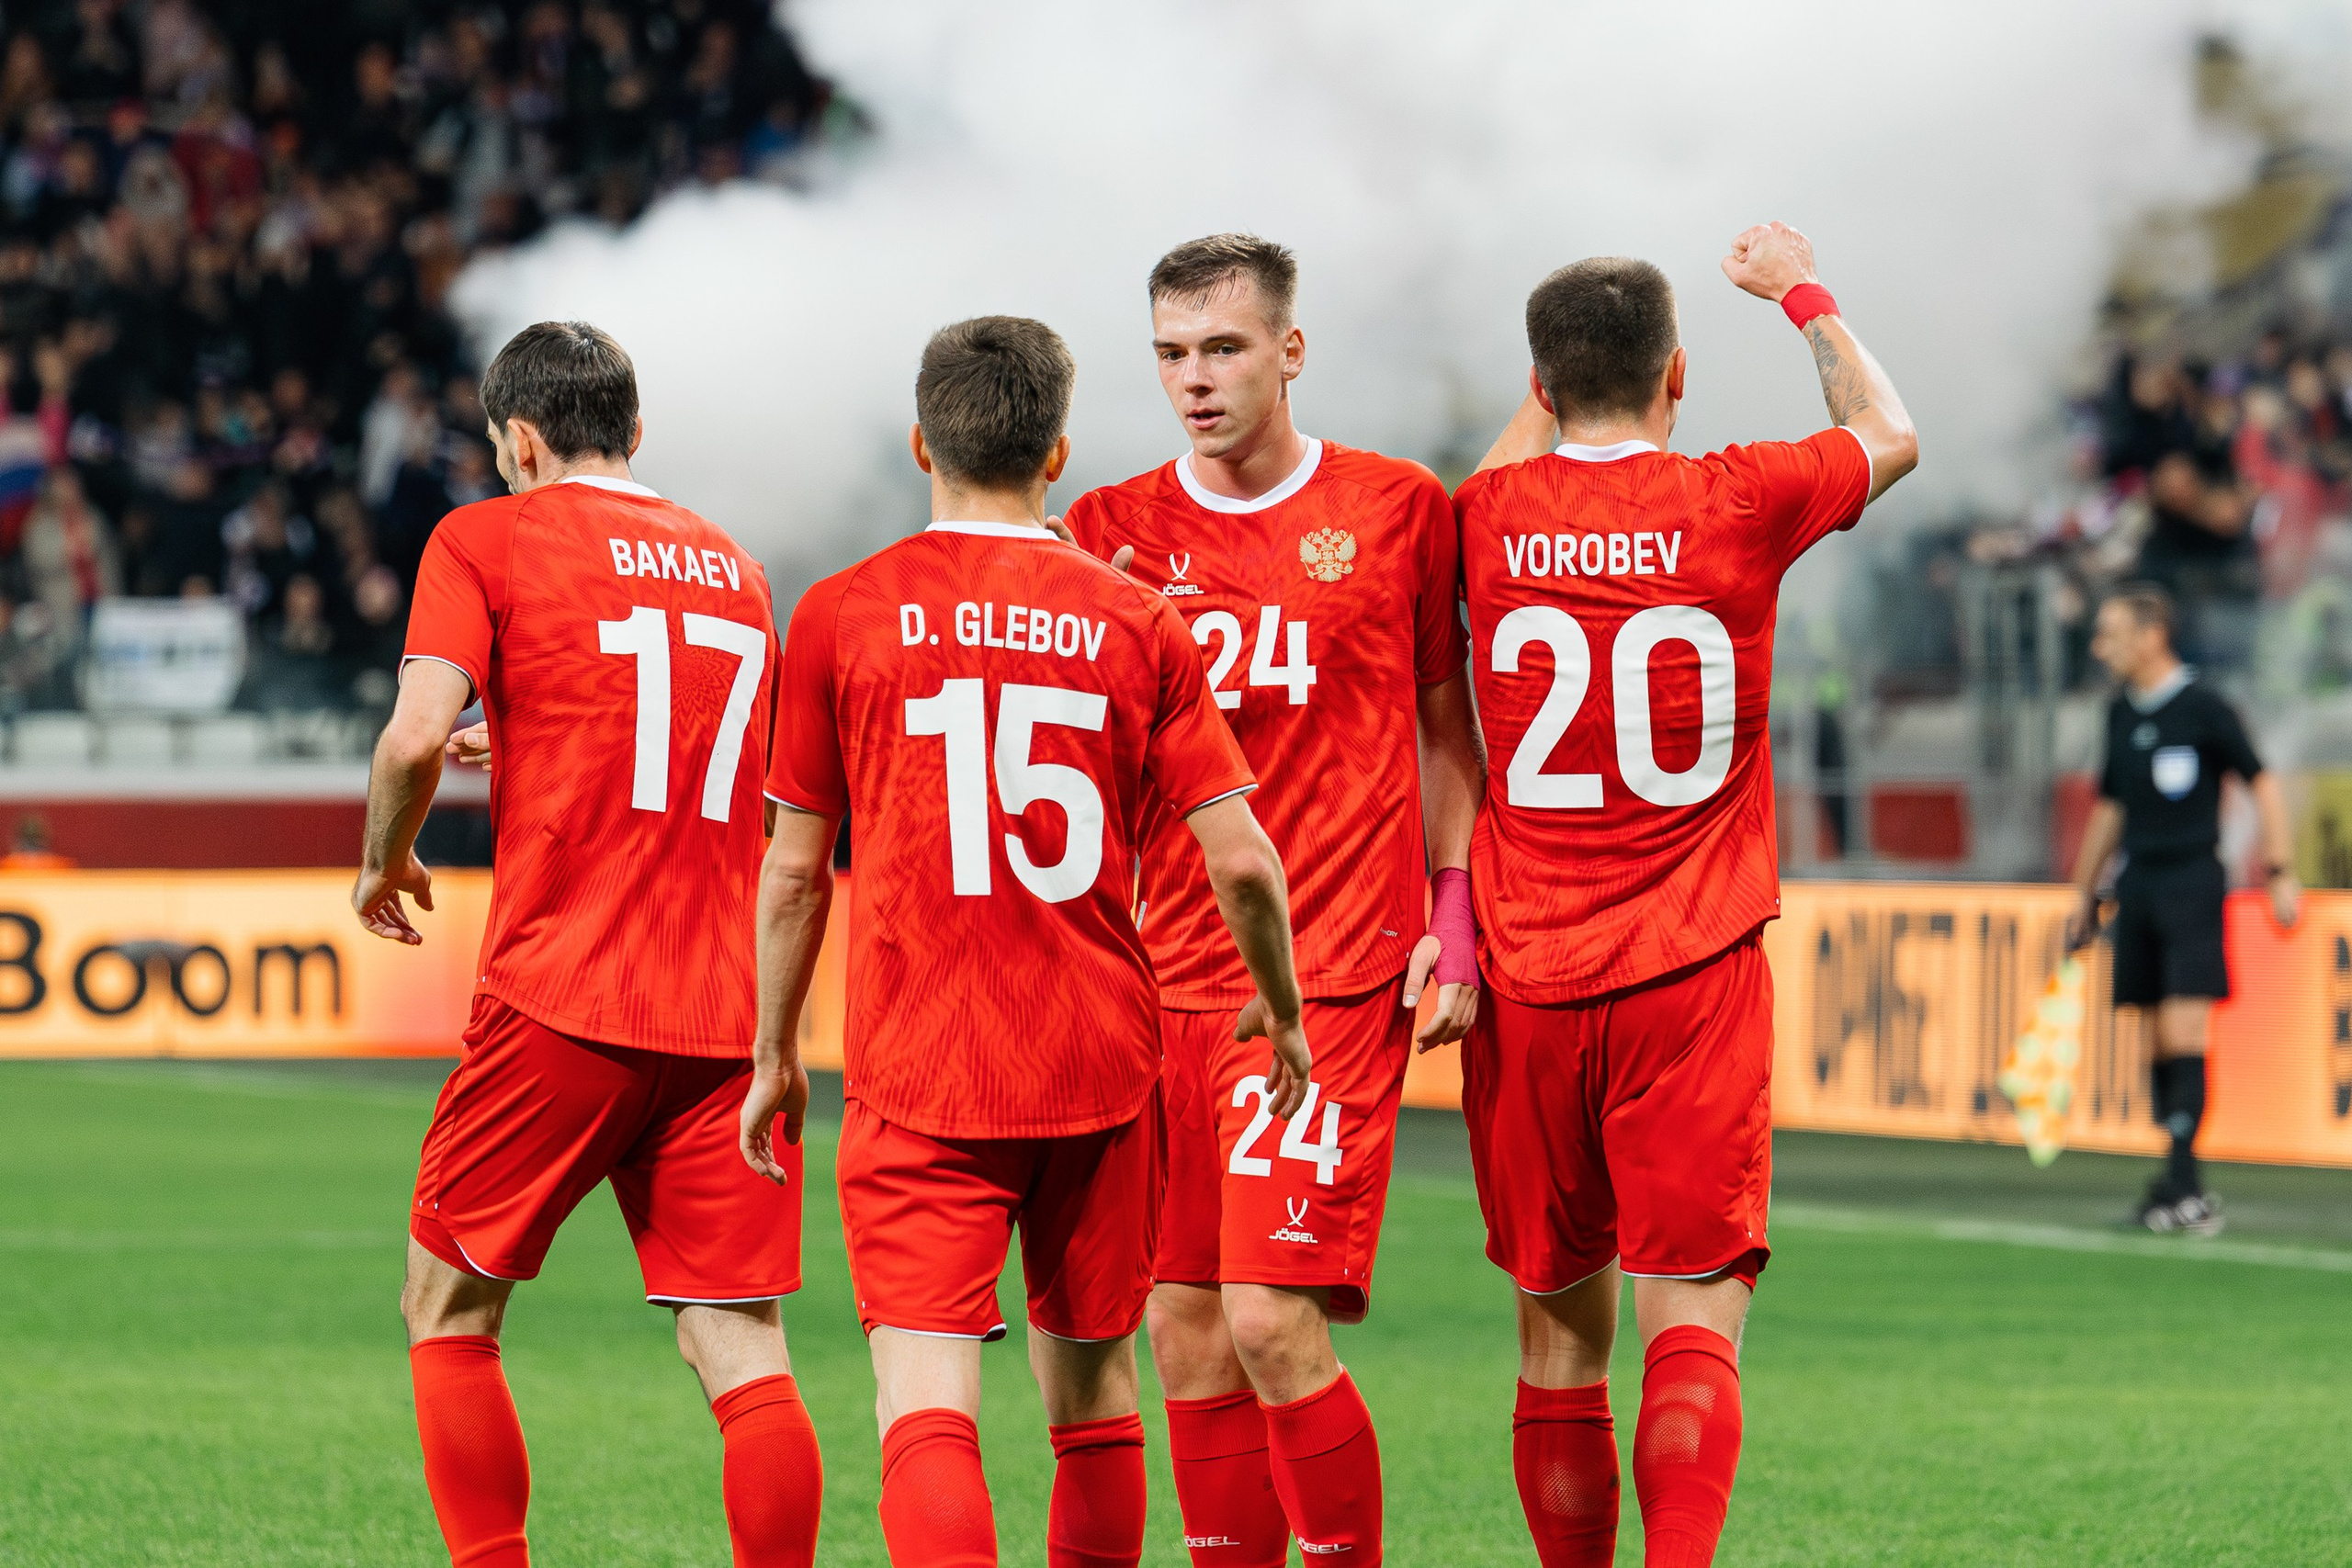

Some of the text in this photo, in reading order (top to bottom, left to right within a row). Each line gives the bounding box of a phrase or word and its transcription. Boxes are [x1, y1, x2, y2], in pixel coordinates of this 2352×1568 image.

[608, 538, 741, 592] BAKAEV
[1503, 531, 1682, 578] VOROBEV
[899, 602, 1106, 662] D. GLEBOV
[1191, 604, 1317, 710] 24
[597, 605, 766, 824] 17
[1492, 605, 1736, 808] 20
[904, 678, 1108, 904] 15
[1228, 1075, 1343, 1185] 24
[1269, 1227, 1318, 1244] JÖGEL
[1184, 1535, 1240, 1548] ÖGEL
[1297, 1536, 1352, 1554] ÖGEL
